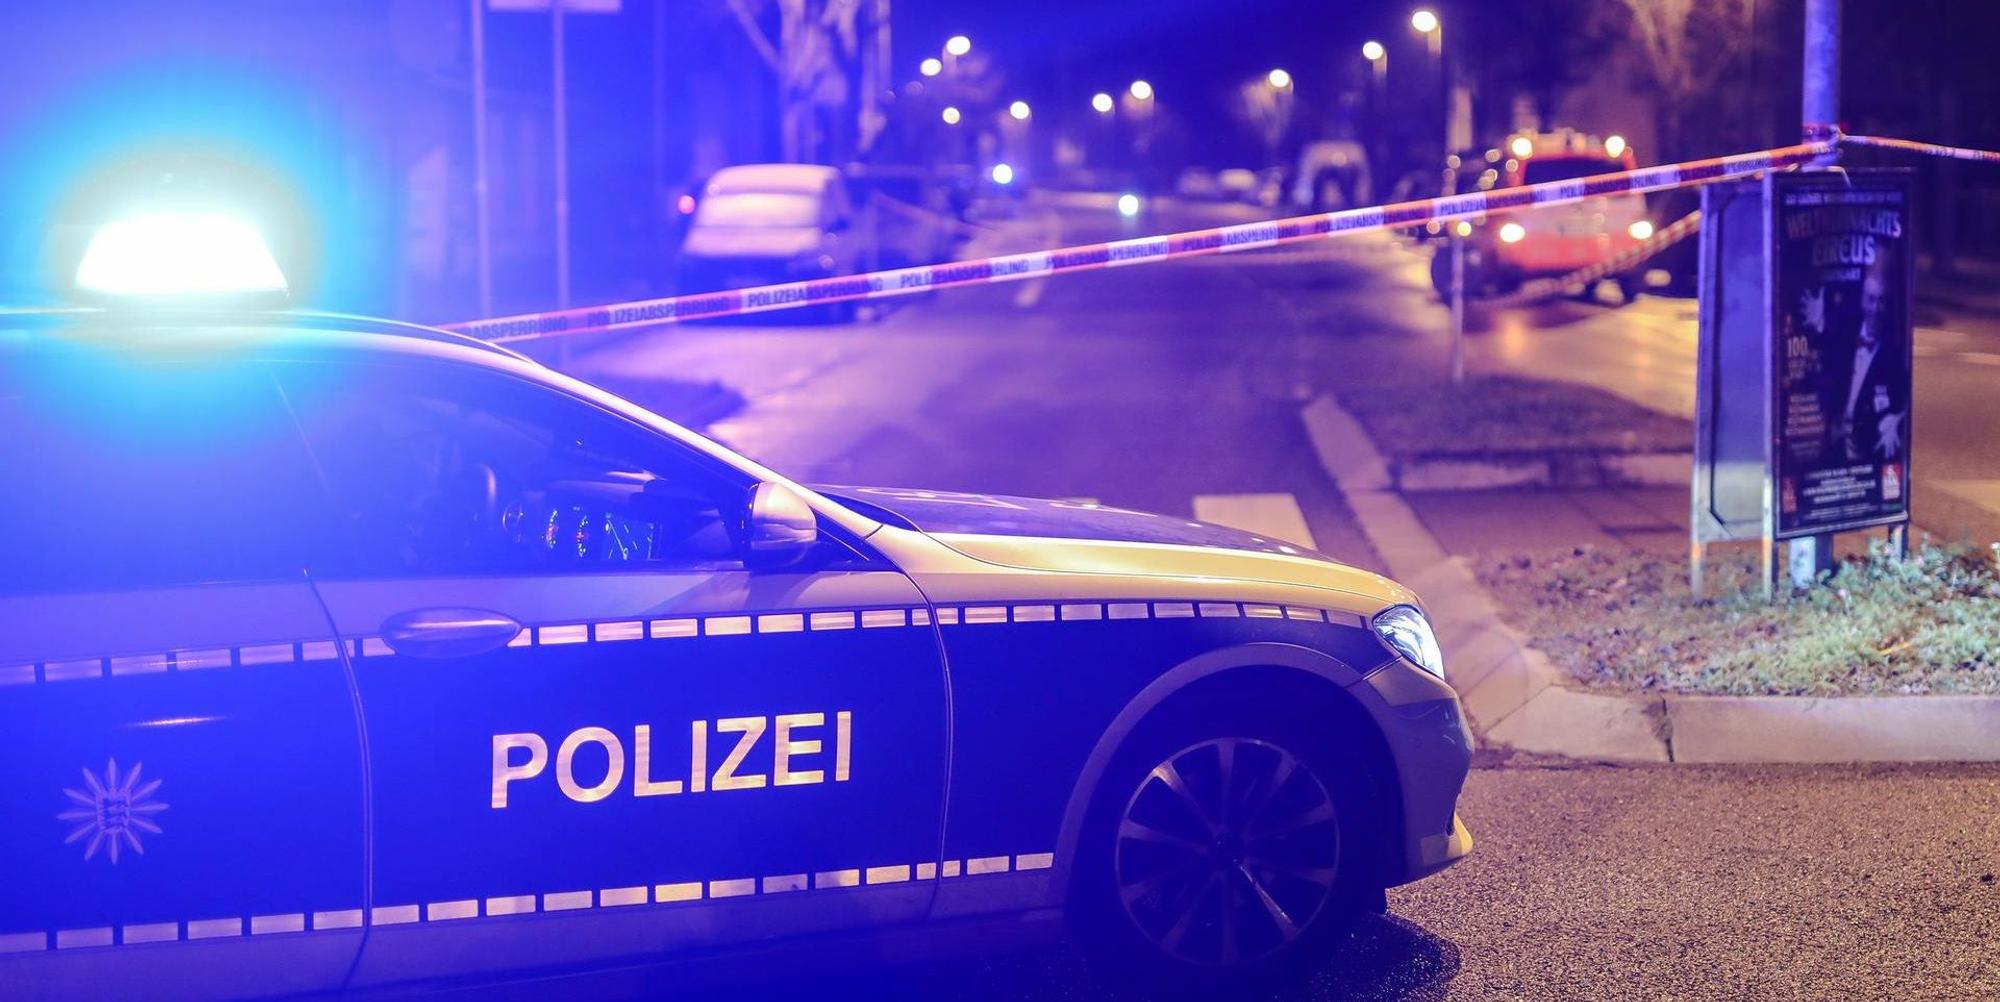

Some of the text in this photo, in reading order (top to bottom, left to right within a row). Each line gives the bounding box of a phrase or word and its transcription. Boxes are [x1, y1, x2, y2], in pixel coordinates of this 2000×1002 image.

[587, 294, 730, 328] POLIZEIABSPERRUNG
[748, 276, 883, 307] POLIZEIABSPERRUNG
[1787, 335, 1808, 358] 100
[491, 710, 851, 809] POLIZEI
